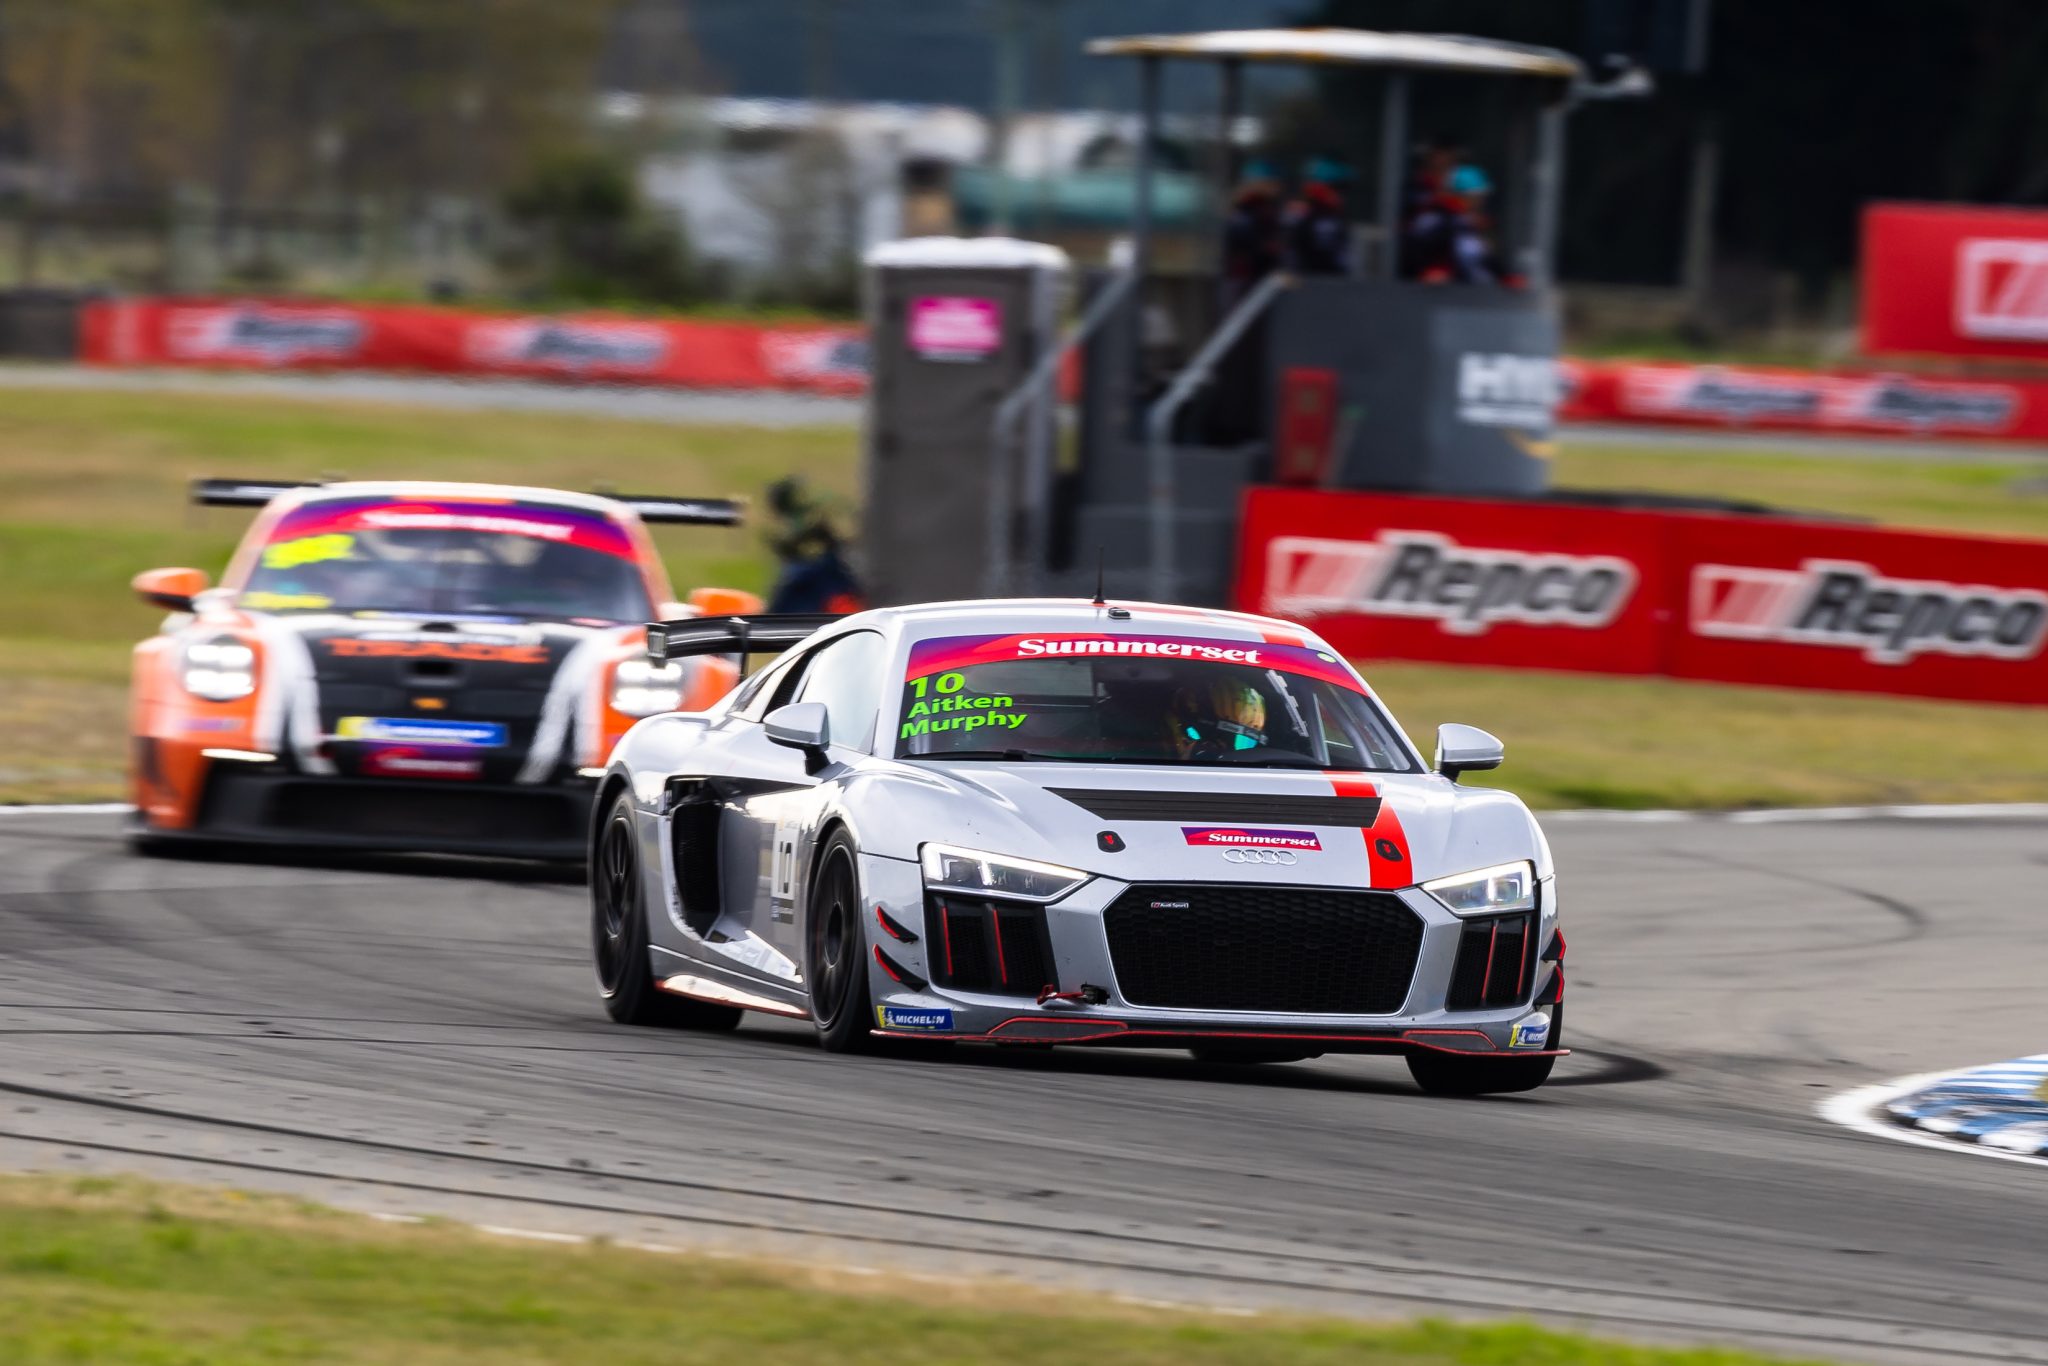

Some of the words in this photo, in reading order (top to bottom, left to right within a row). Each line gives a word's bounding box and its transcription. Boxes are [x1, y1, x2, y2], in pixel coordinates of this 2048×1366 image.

[1374, 543, 1621, 620] Repco
[1793, 572, 2044, 651] Repco
[1017, 638, 1262, 663] Summerset
[909, 672, 966, 698] 10
[907, 695, 1013, 718] Aitken
[900, 711, 1028, 739] Murphy
[1208, 833, 1317, 846] Summerset
[895, 1015, 945, 1024] MICHELIN
